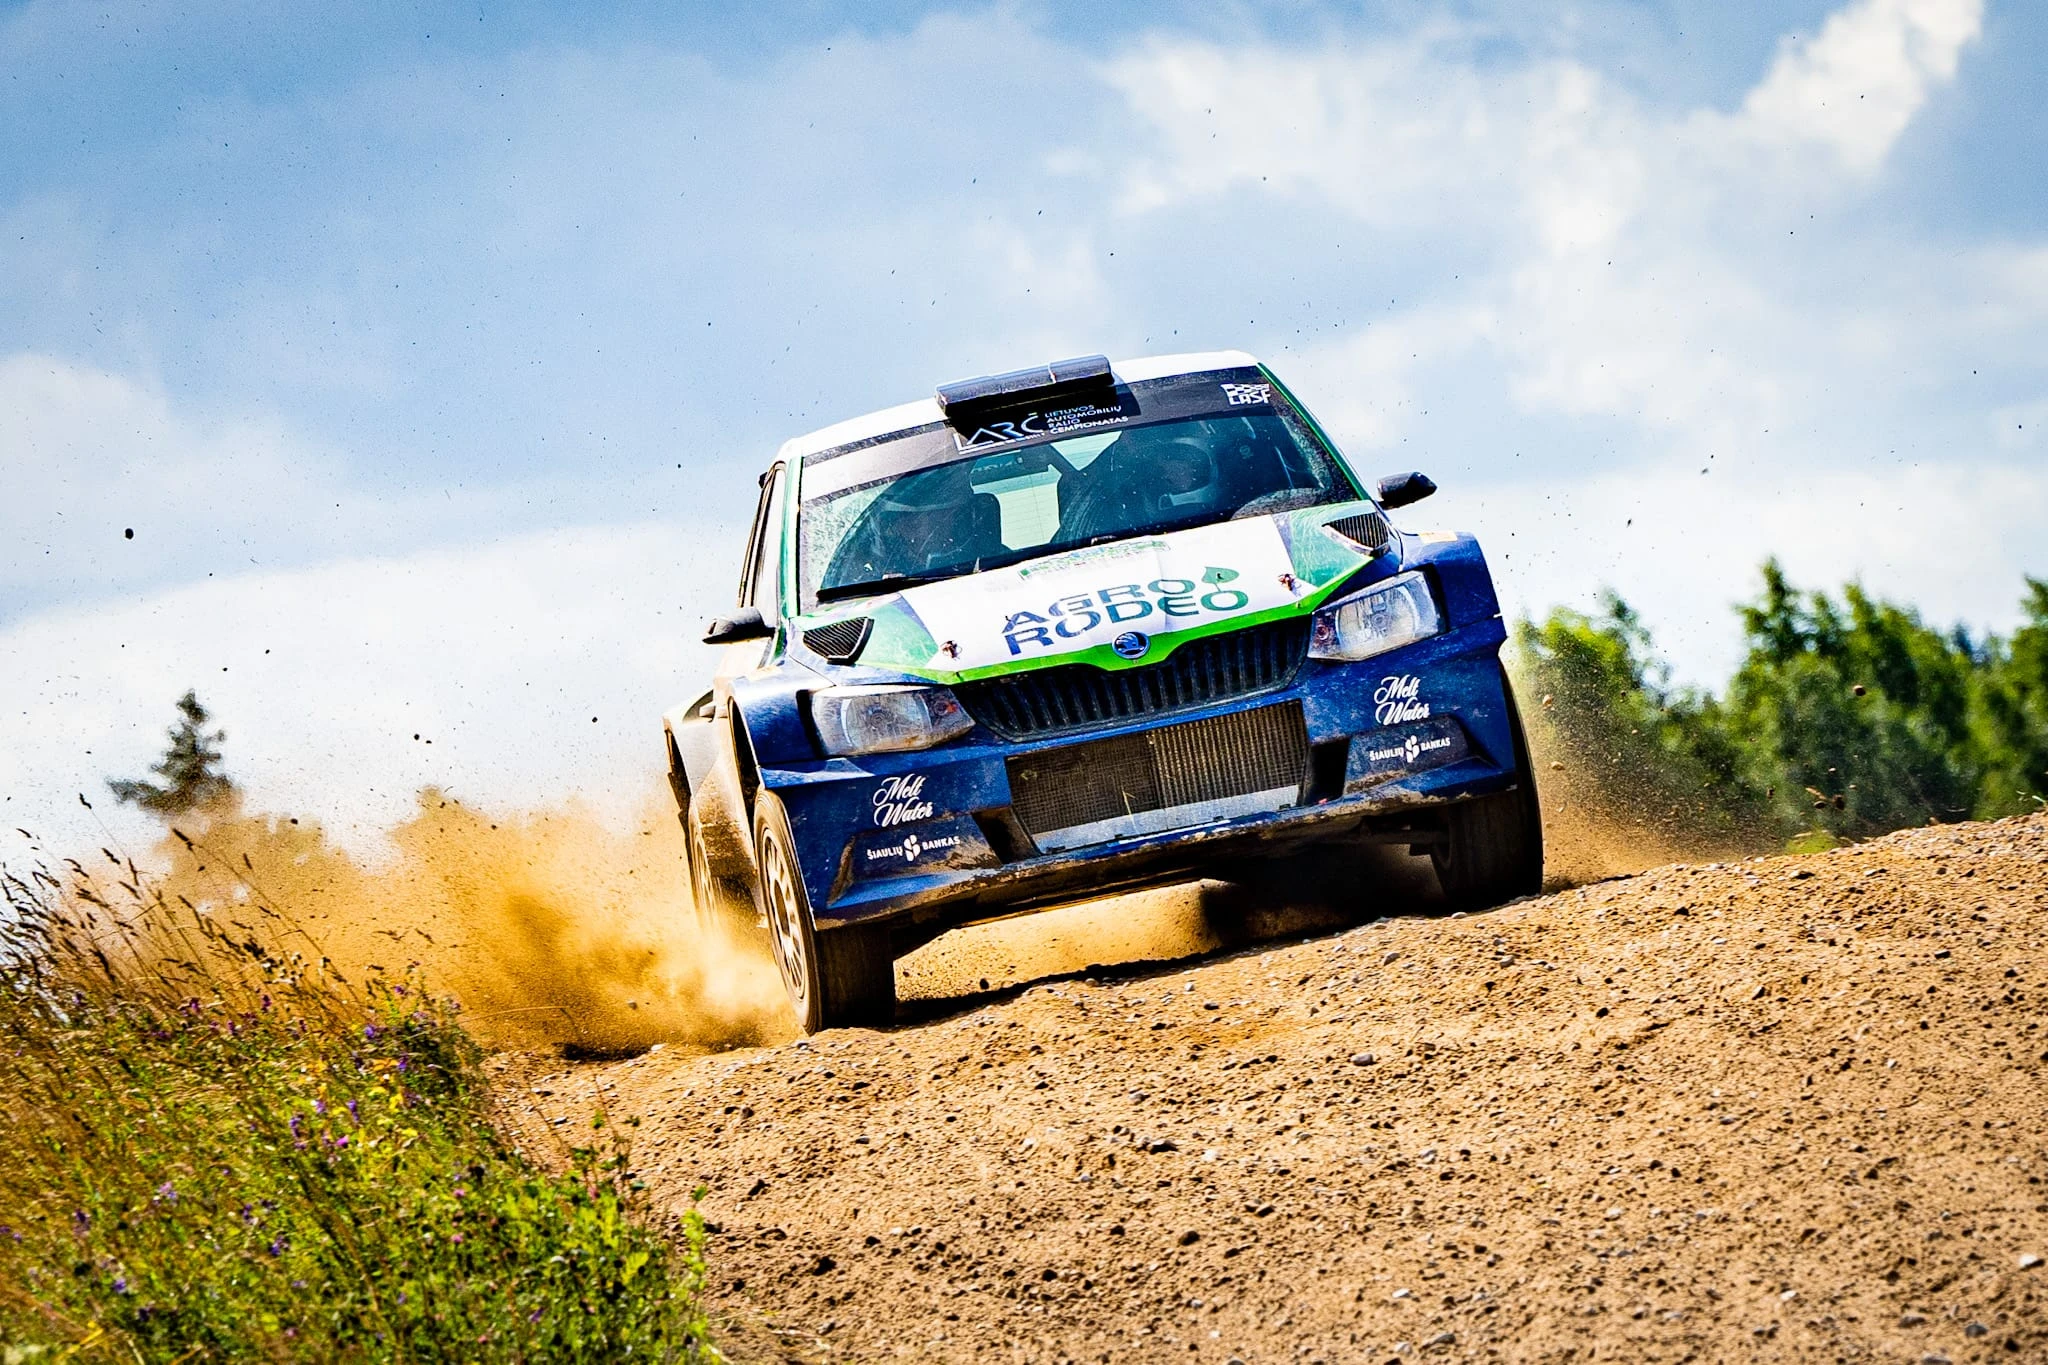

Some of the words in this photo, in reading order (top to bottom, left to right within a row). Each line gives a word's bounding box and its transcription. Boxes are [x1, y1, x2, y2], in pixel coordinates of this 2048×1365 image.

[1045, 405, 1095, 418] LIETUVOS
[1048, 419, 1080, 429] RALIO
[1001, 579, 1196, 634] AGRO
[1004, 590, 1249, 656] RODEO
[1374, 674, 1421, 704] Melt
[1375, 697, 1430, 726] Water
[1420, 737, 1451, 751] BANKAS
[873, 773, 926, 807] Melt
[874, 797, 934, 828] Water
[866, 846, 903, 860] ŠIAULIŲ
[921, 836, 961, 850] BANKAS
